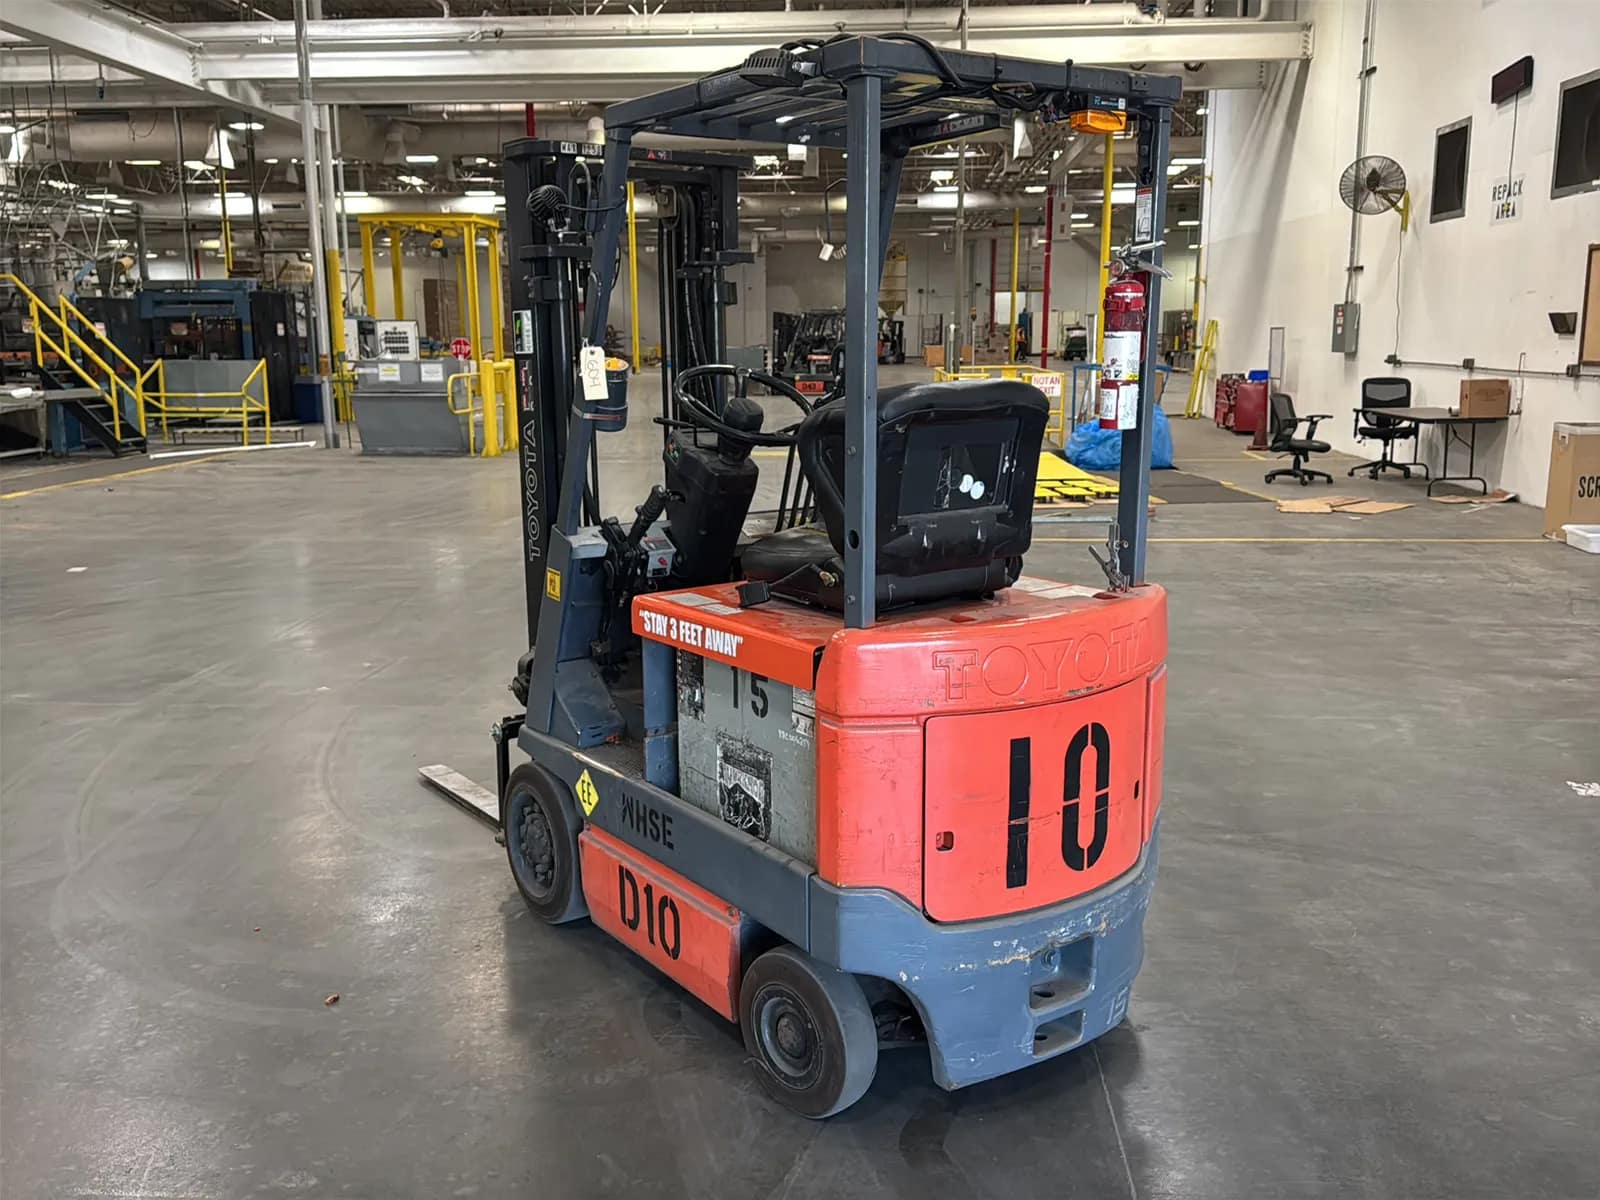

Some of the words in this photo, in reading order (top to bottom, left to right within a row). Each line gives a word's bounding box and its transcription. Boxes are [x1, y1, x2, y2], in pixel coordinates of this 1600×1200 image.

[452, 343, 471, 354] STOP
[1033, 376, 1048, 385] NOT
[1049, 375, 1061, 385] AN
[522, 419, 542, 562] TOYOTA
[670, 617, 678, 640] 3
[680, 620, 704, 647] FEET
[581, 779, 593, 807] EE
[1006, 721, 1111, 889] 10
[618, 864, 681, 960] D10
